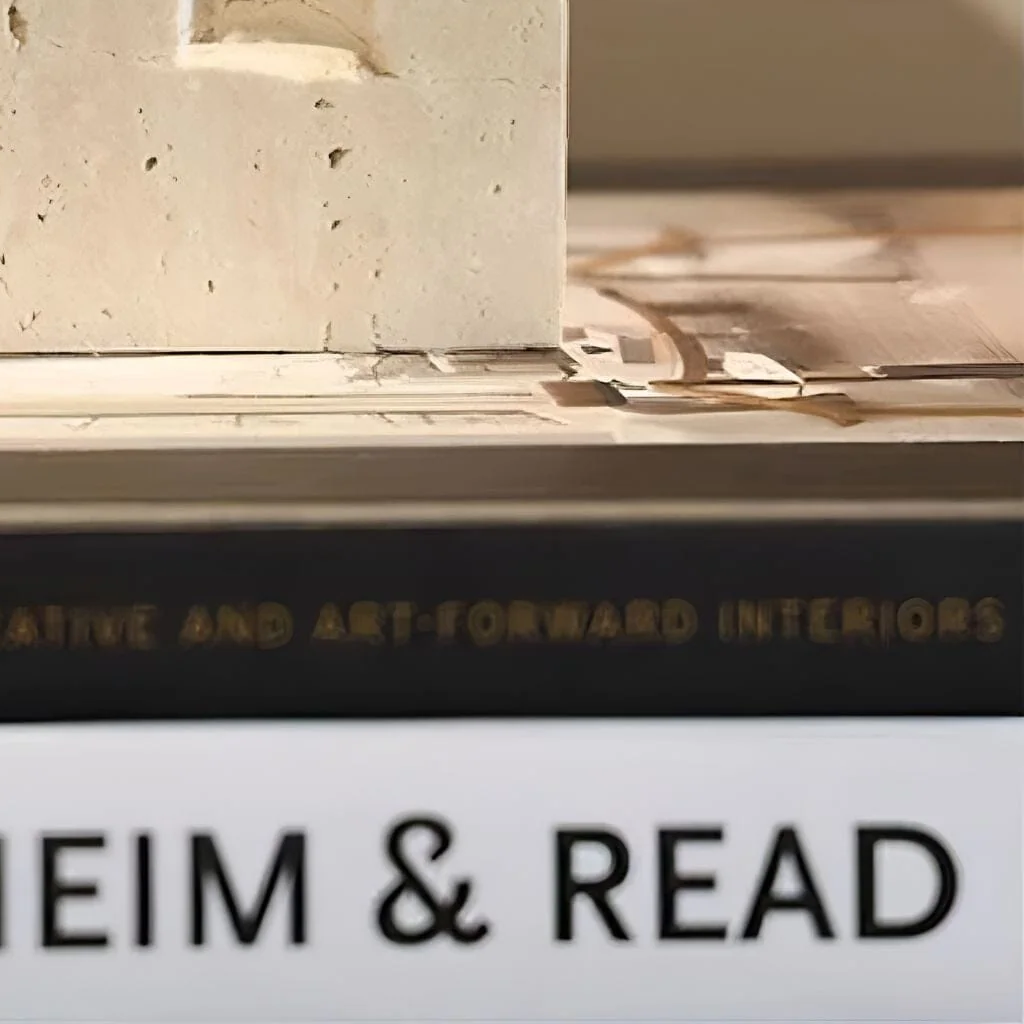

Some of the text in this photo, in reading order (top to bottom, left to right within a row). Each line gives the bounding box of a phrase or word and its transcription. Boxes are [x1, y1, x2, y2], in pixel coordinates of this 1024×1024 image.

[178, 601, 296, 648] AND
[717, 594, 1005, 643] INTERIORS
[372, 813, 493, 949] &
[551, 821, 962, 945] READ
